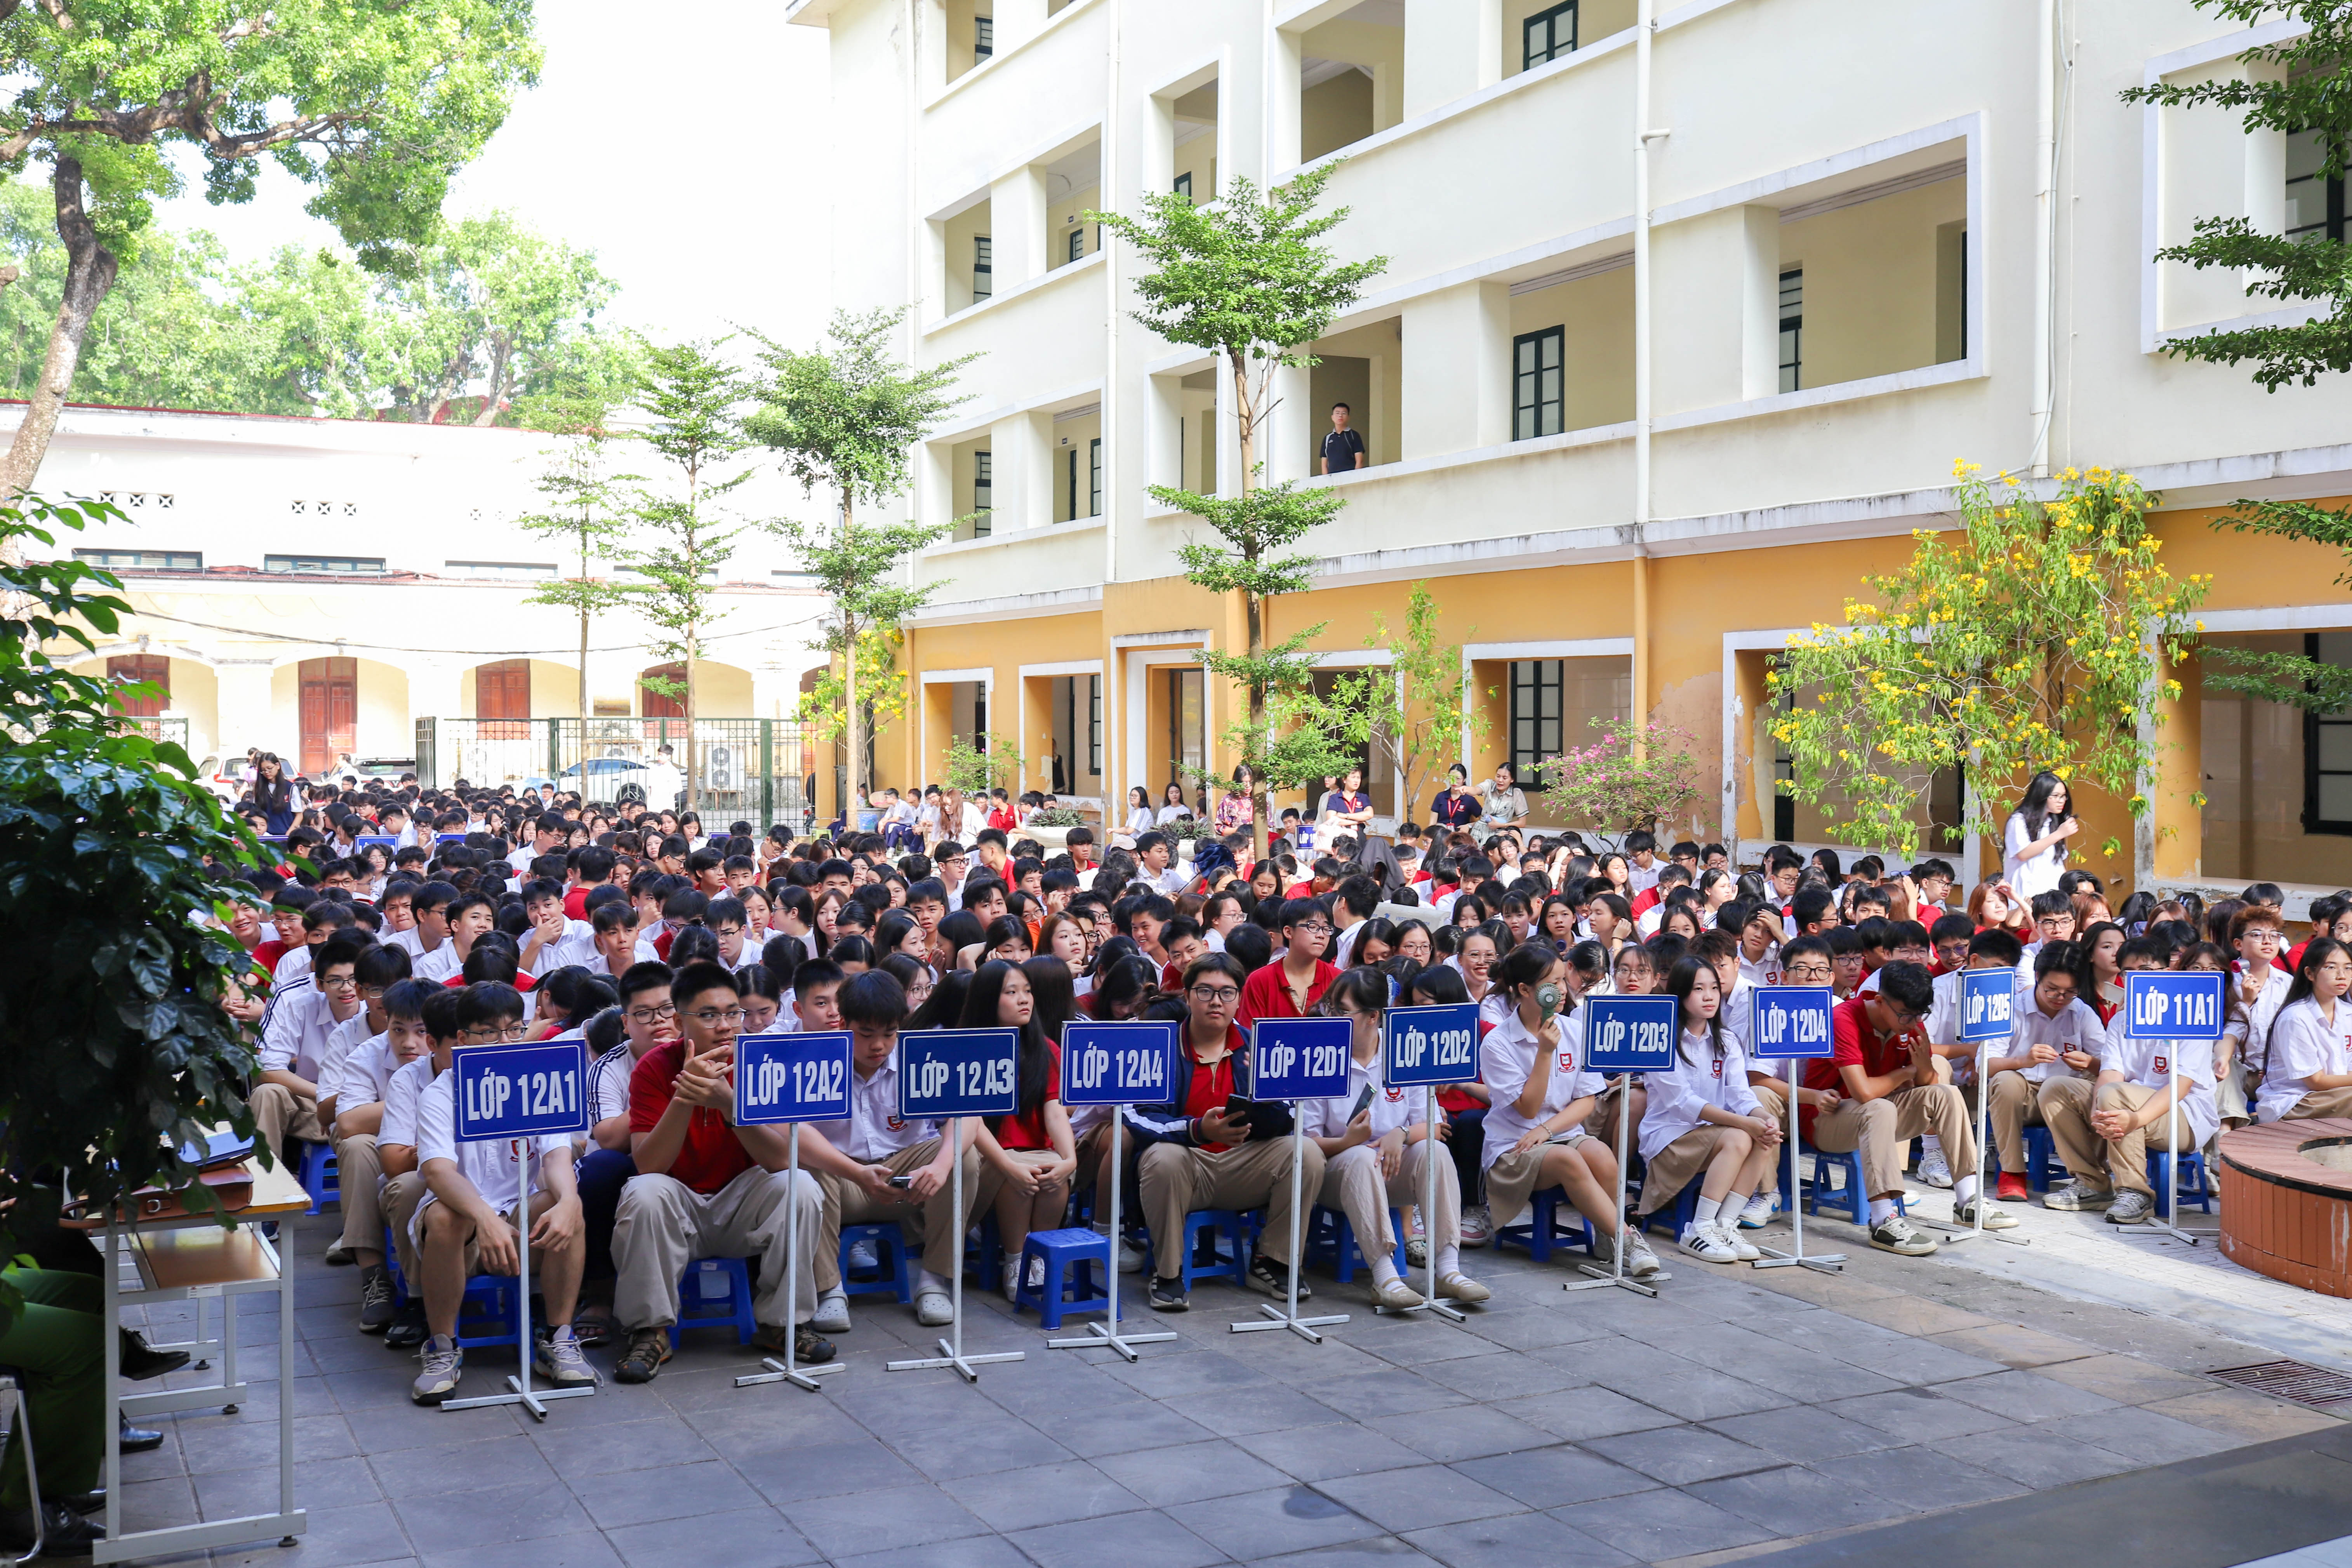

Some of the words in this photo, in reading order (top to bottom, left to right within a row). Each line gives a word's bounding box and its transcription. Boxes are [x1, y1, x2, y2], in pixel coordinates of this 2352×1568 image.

[1761, 1001, 1787, 1043] LỚP
[1791, 1009, 1827, 1043] 12D4
[1966, 987, 1985, 1024] LỚP
[1987, 993, 2010, 1022] 12D5
[2136, 986, 2168, 1025] LỚP
[2174, 993, 2214, 1025] 11A1
[1396, 1025, 1426, 1067] LỚP
[1431, 1030, 1470, 1065] 12D2
[1595, 1013, 1625, 1052] LỚP
[1631, 1022, 1668, 1052] 12D3
[747, 1054, 785, 1106] LỚP
[793, 1060, 843, 1102] 12A2
[910, 1052, 948, 1098] LỚP
[957, 1059, 1014, 1095] 12A3
[1072, 1042, 1108, 1088] LỚP
[1116, 1050, 1163, 1087] 12A4
[1260, 1040, 1295, 1078] LỚP
[1303, 1046, 1345, 1077] 12D1
[467, 1067, 510, 1120] LỚP
[518, 1071, 575, 1116] 12A1
